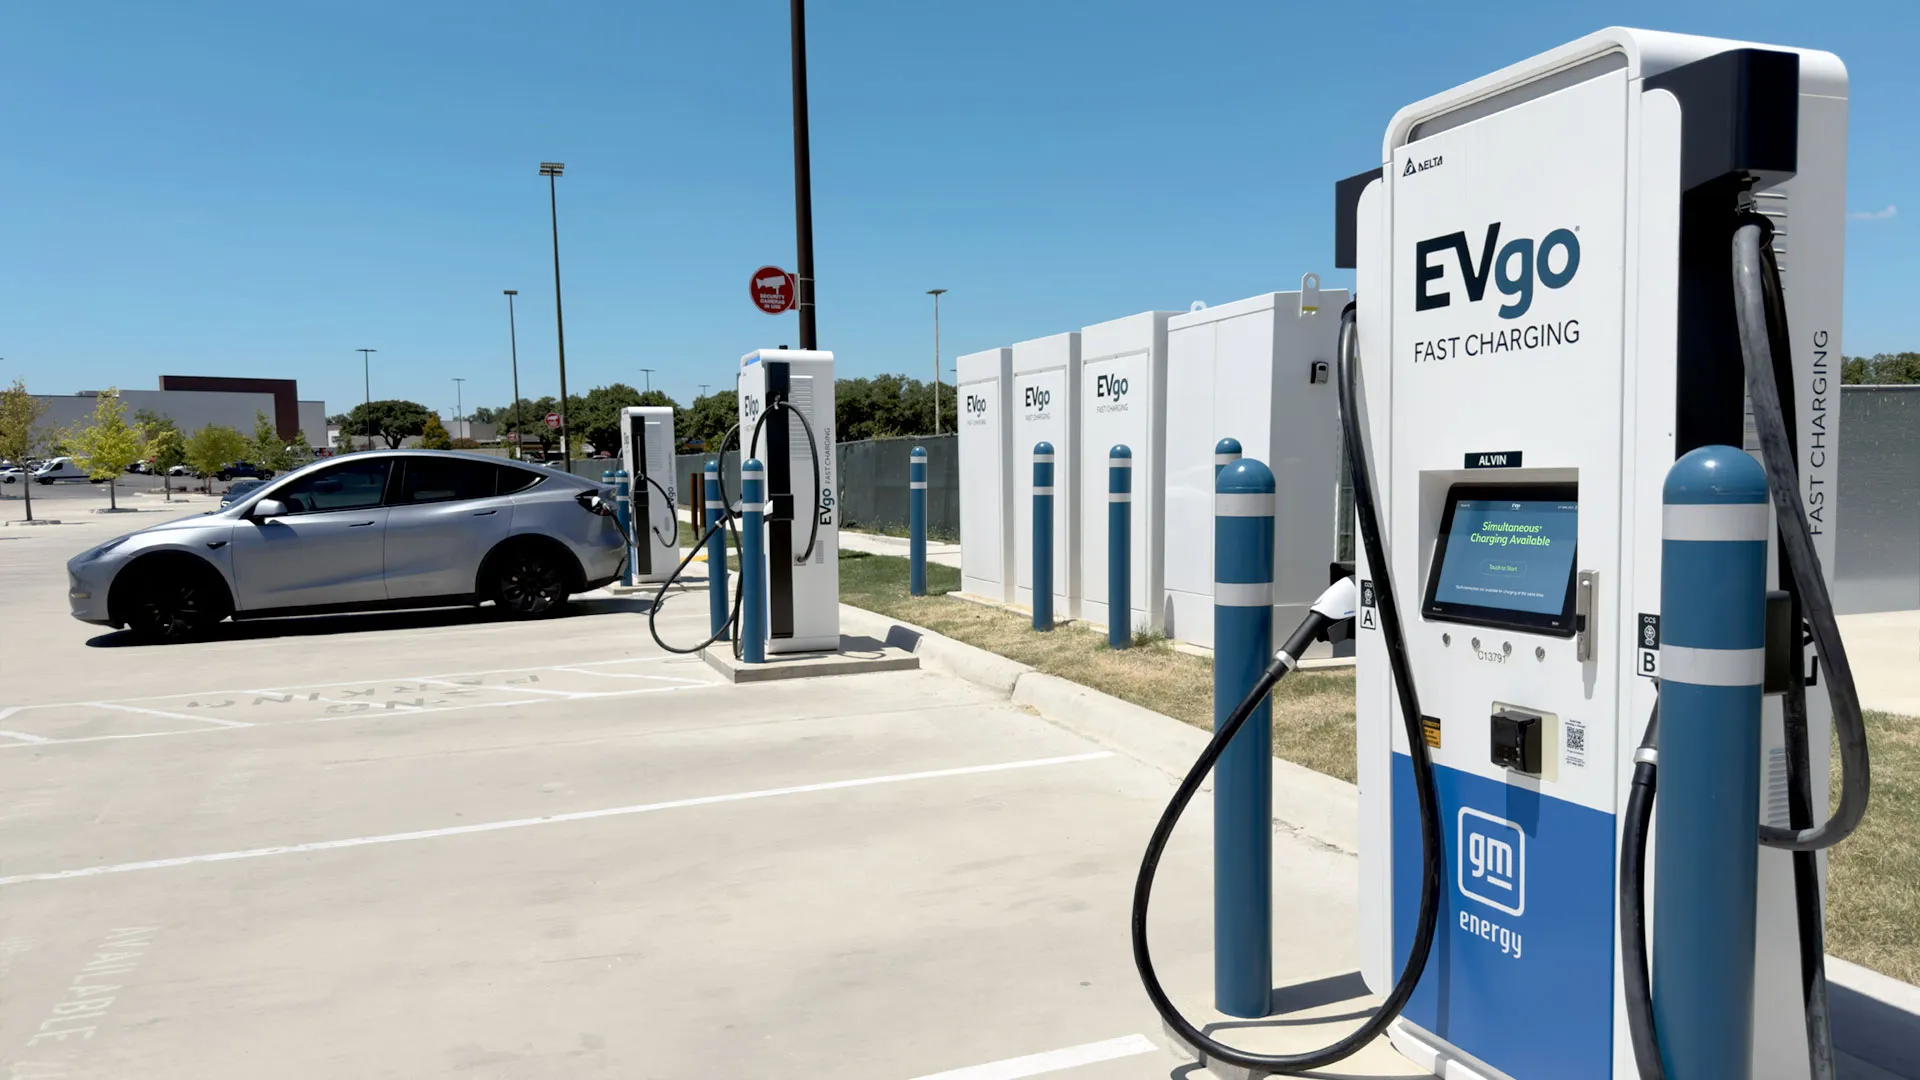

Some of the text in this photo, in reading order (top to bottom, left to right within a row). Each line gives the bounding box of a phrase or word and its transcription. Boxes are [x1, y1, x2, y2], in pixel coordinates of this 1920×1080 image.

[1418, 155, 1443, 172] DELTA
[1416, 221, 1581, 320] EVgo
[1414, 319, 1580, 363] FAST CHARGING
[1025, 386, 1050, 411] EVgo
[1097, 373, 1129, 402] EVgo
[967, 394, 986, 418] EVgo
[1808, 329, 1828, 536] FAST CHARGING
[1478, 455, 1507, 466] ALVIN
[820, 488, 835, 525] EVgo
[1470, 533, 1551, 546] Charging Available
[1363, 609, 1373, 626] A
[1644, 616, 1656, 624] CCS
[1478, 650, 1506, 664] C13791
[1643, 651, 1656, 672] B
[1469, 832, 1513, 879] gm
[1459, 910, 1522, 959] energy
